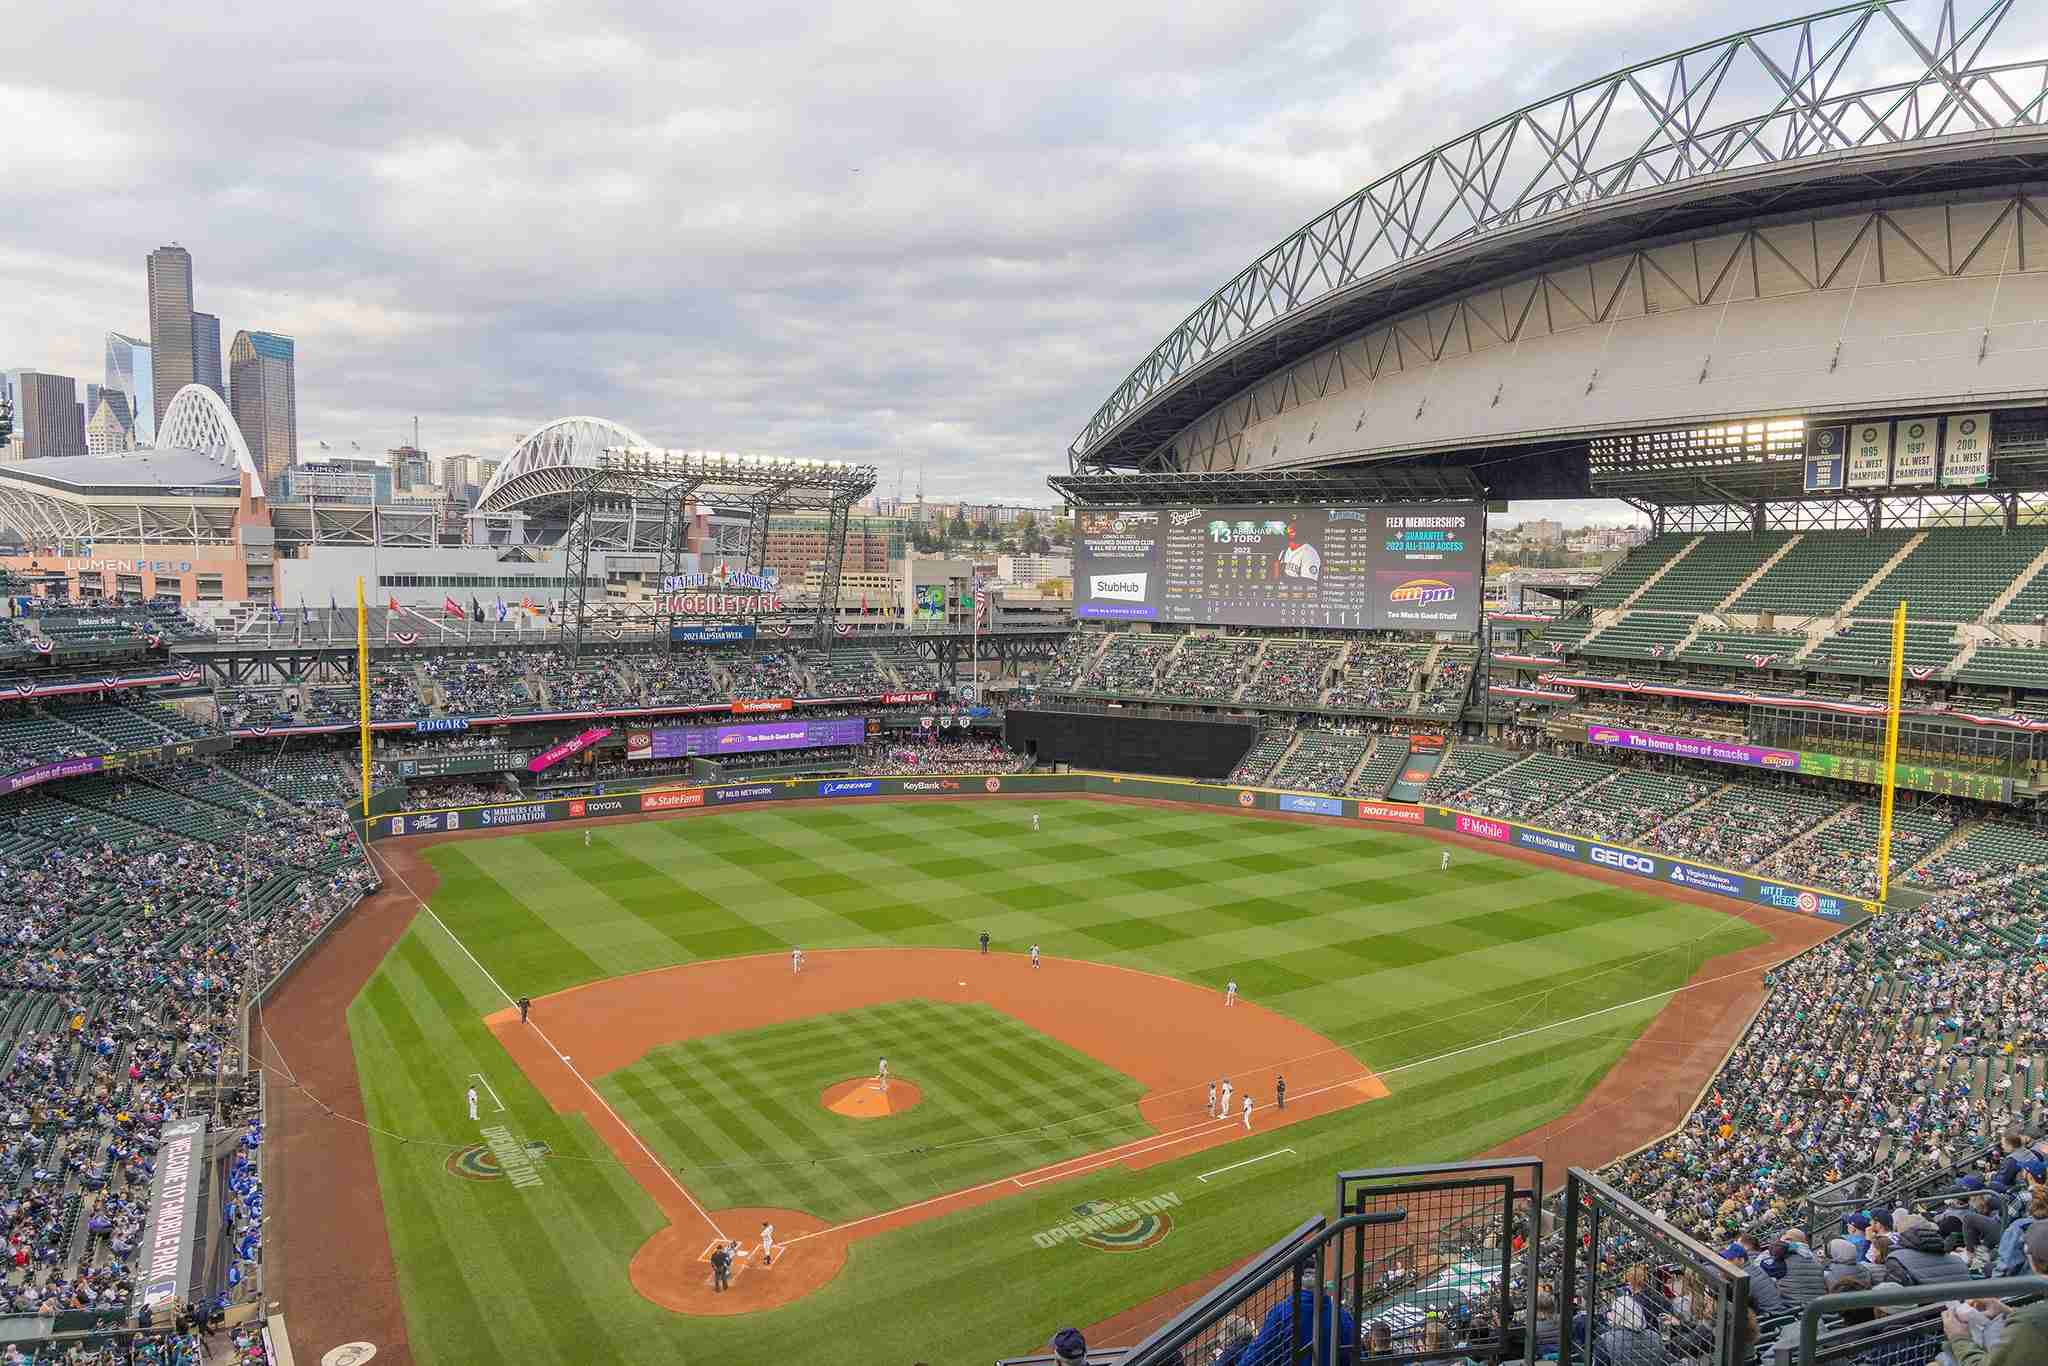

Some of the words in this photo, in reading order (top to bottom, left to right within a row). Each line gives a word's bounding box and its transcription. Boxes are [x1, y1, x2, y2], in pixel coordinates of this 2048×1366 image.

[1957, 440, 1977, 450] 2001
[1861, 447, 1878, 456] 1995
[1912, 456, 1930, 465] WEST
[1963, 453, 1982, 462] WEST
[1866, 460, 1882, 468] WEST
[1850, 470, 1886, 480] CHAMPIONS
[1895, 467, 1933, 478] CHAMPIONS
[1945, 464, 1985, 476] CHAMPIONS
[1171, 508, 1201, 525] Royals
[1386, 517, 1404, 528] FLEX
[1405, 517, 1466, 528] MEMBERSHIPS
[1211, 528, 1231, 543] 13
[1233, 535, 1261, 543] TORO
[67, 560, 131, 570] LUMEN
[136, 560, 191, 572] FIELD
[1097, 581, 1139, 592] StubHub
[652, 593, 734, 614] T-MOBILE
[736, 595, 783, 613] PARK
[418, 720, 469, 731] EDGARS
[1629, 735, 1647, 746] The
[1648, 738, 1674, 750] home
[1676, 742, 1698, 754] base
[1700, 745, 1711, 755] of
[1713, 748, 1749, 760] snacks
[835, 782, 872, 790] BOEING
[904, 782, 939, 792] KeyBank
[587, 801, 622, 810] TOYOTA
[494, 811, 545, 824] FOUNDATION
[1364, 806, 1388, 816] ROOT
[1389, 810, 1420, 819] SPORTS
[1591, 847, 1654, 873] GEICO
[1760, 886, 1773, 895] HIT
[1819, 898, 1836, 908] WIN
[163, 1136, 192, 1184] WELCOME
[161, 1183, 187, 1199] TO
[155, 1198, 185, 1248] T-MOBILE
[1032, 1206, 1141, 1248] OPENING
[1136, 1191, 1184, 1215] DAY
[151, 1247, 178, 1281] PARK
